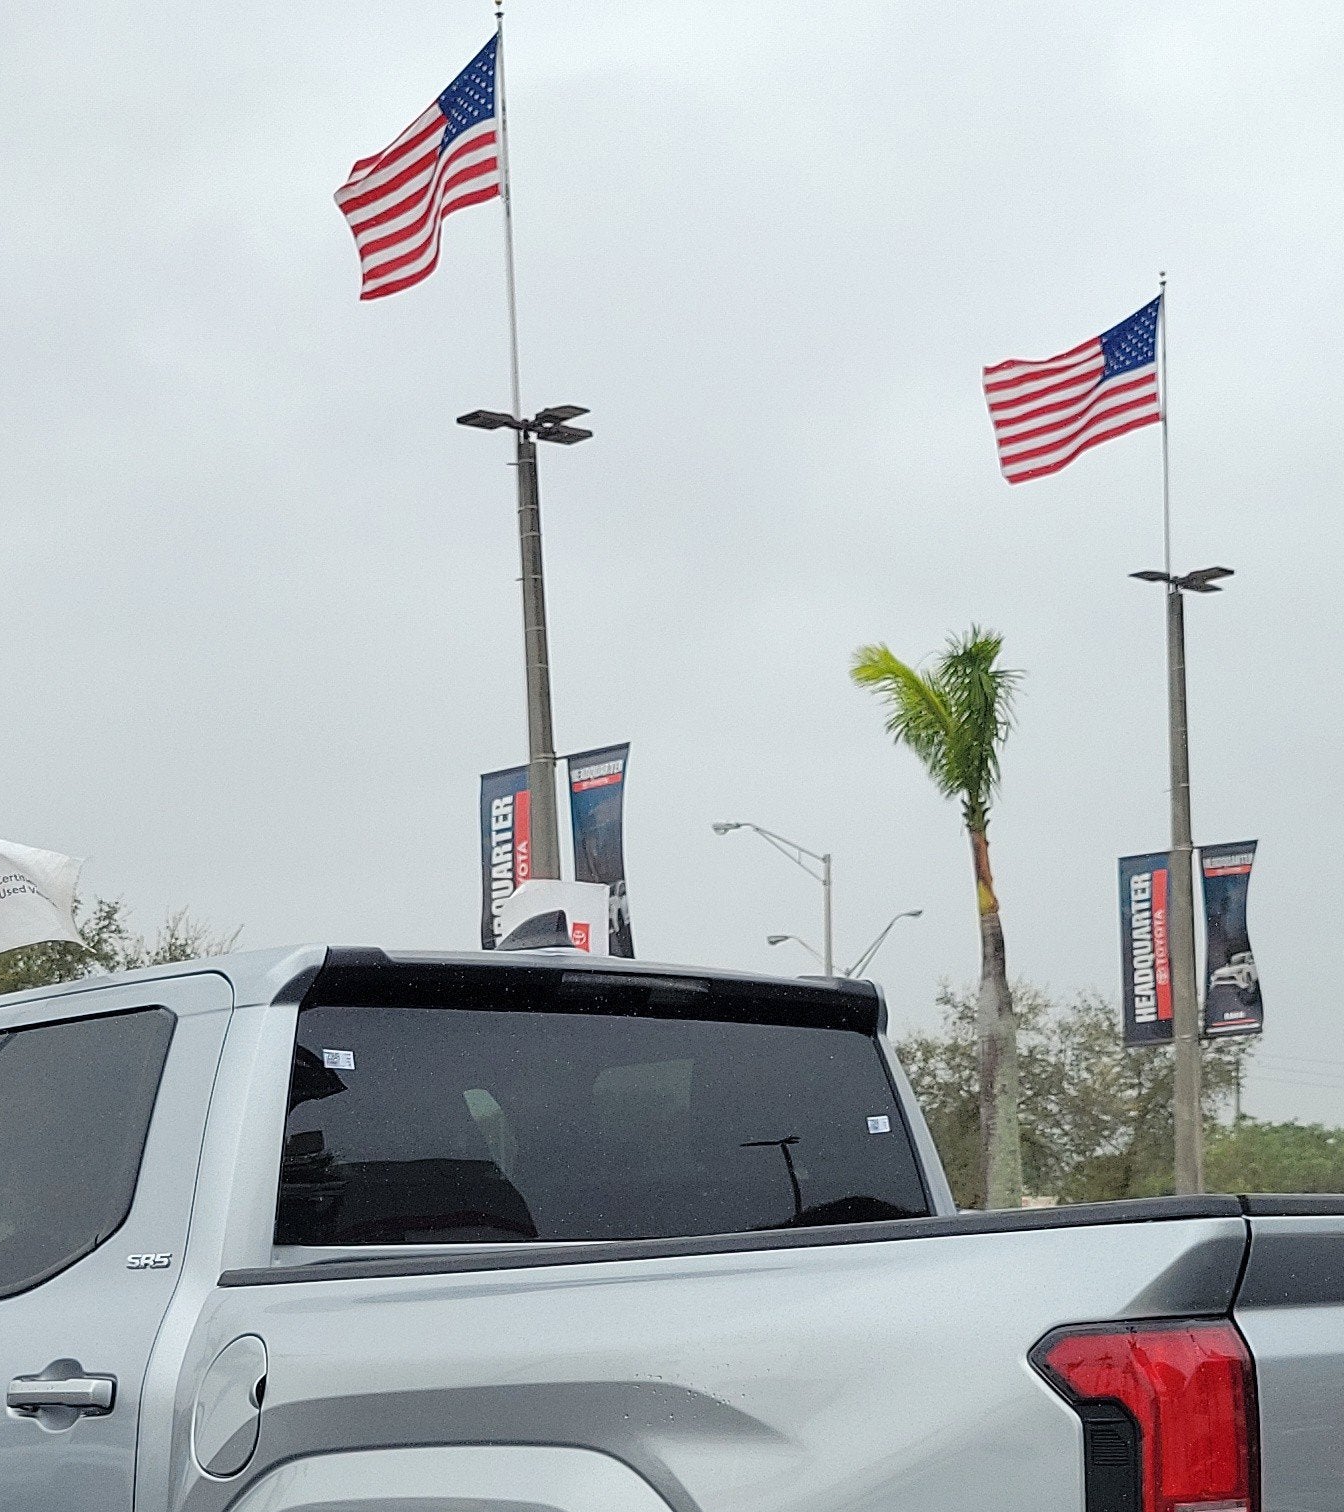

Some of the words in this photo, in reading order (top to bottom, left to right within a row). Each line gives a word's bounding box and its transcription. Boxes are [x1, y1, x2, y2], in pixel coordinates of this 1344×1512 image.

[1130, 872, 1157, 1024] HEADQUARTER
[1153, 910, 1170, 970] TOYOTA
[126, 1253, 172, 1270] SR5
